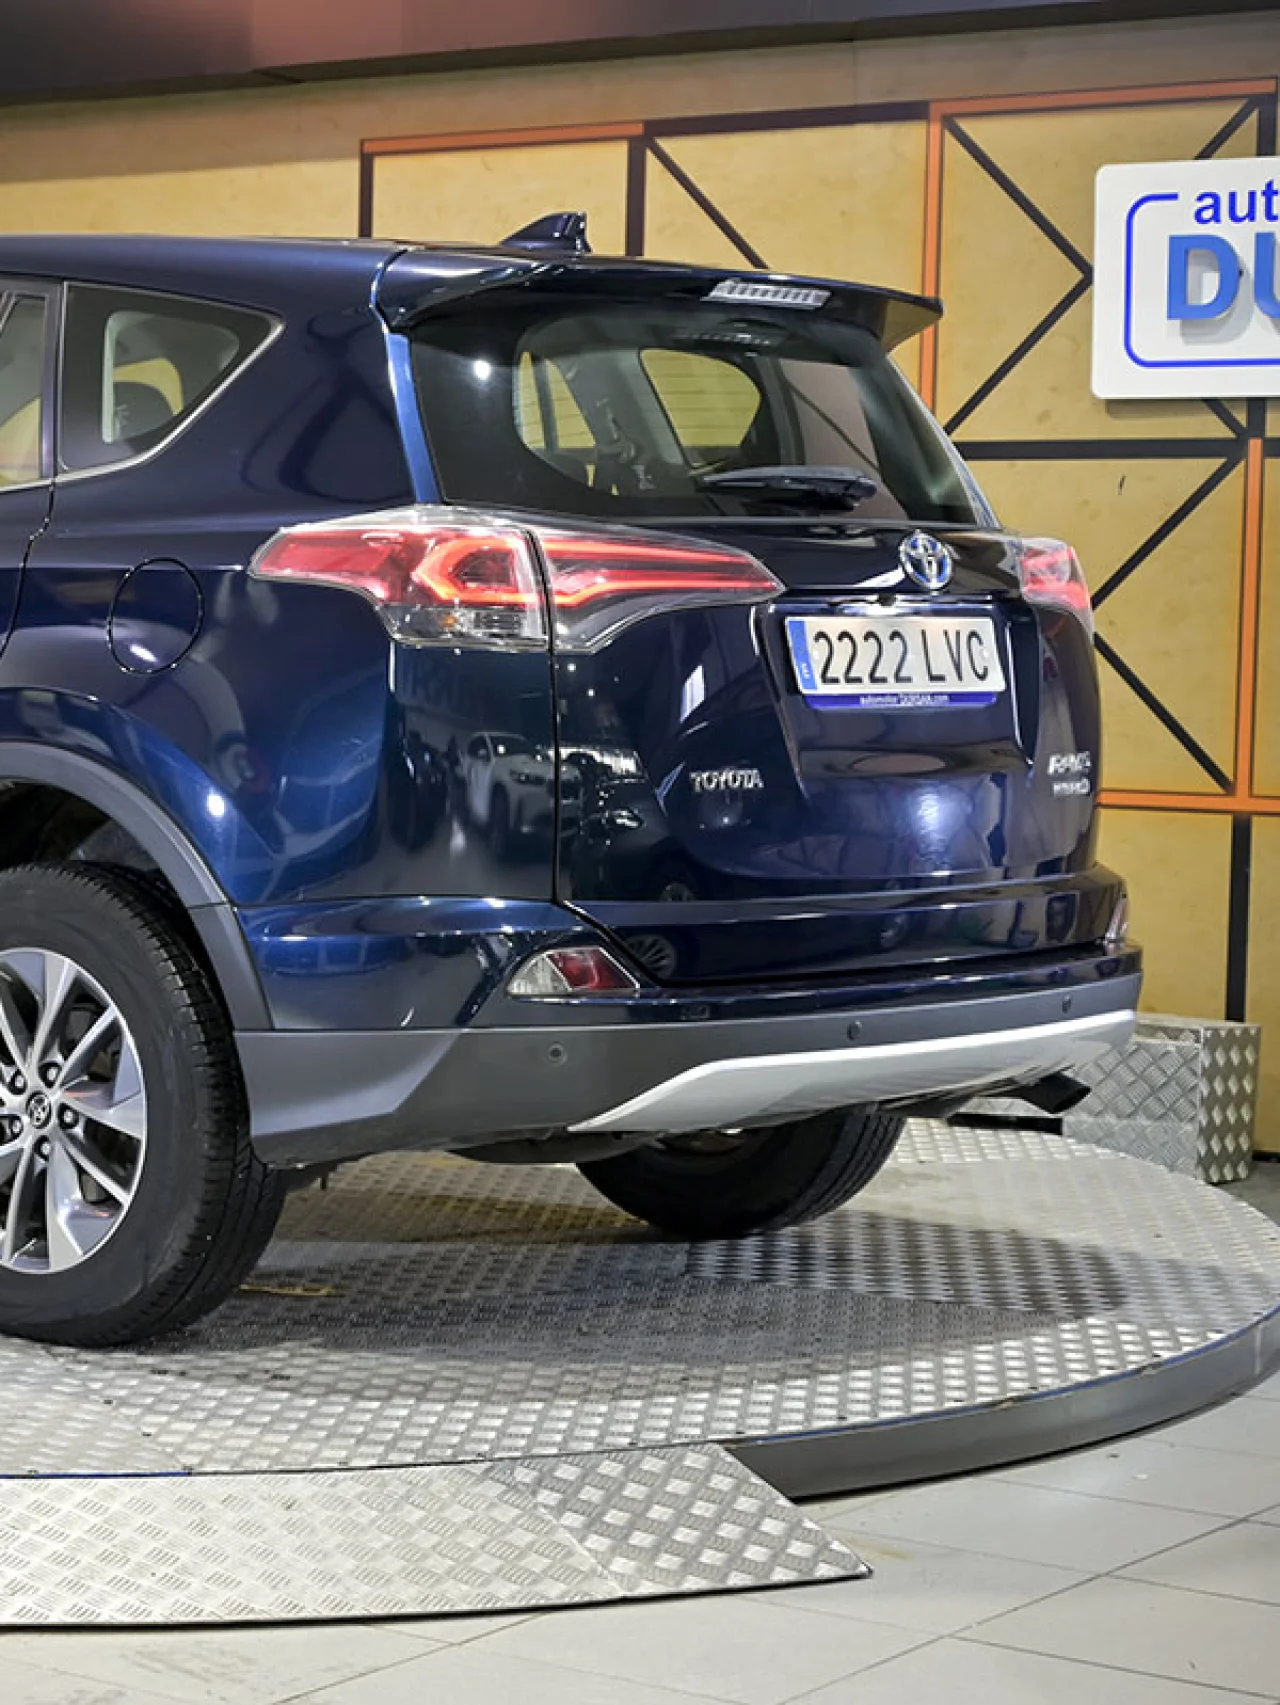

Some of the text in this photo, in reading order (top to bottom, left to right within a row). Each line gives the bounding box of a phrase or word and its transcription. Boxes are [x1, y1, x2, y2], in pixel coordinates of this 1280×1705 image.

[813, 628, 989, 684] 2222 LVC
[689, 768, 764, 792] TOYOTA
